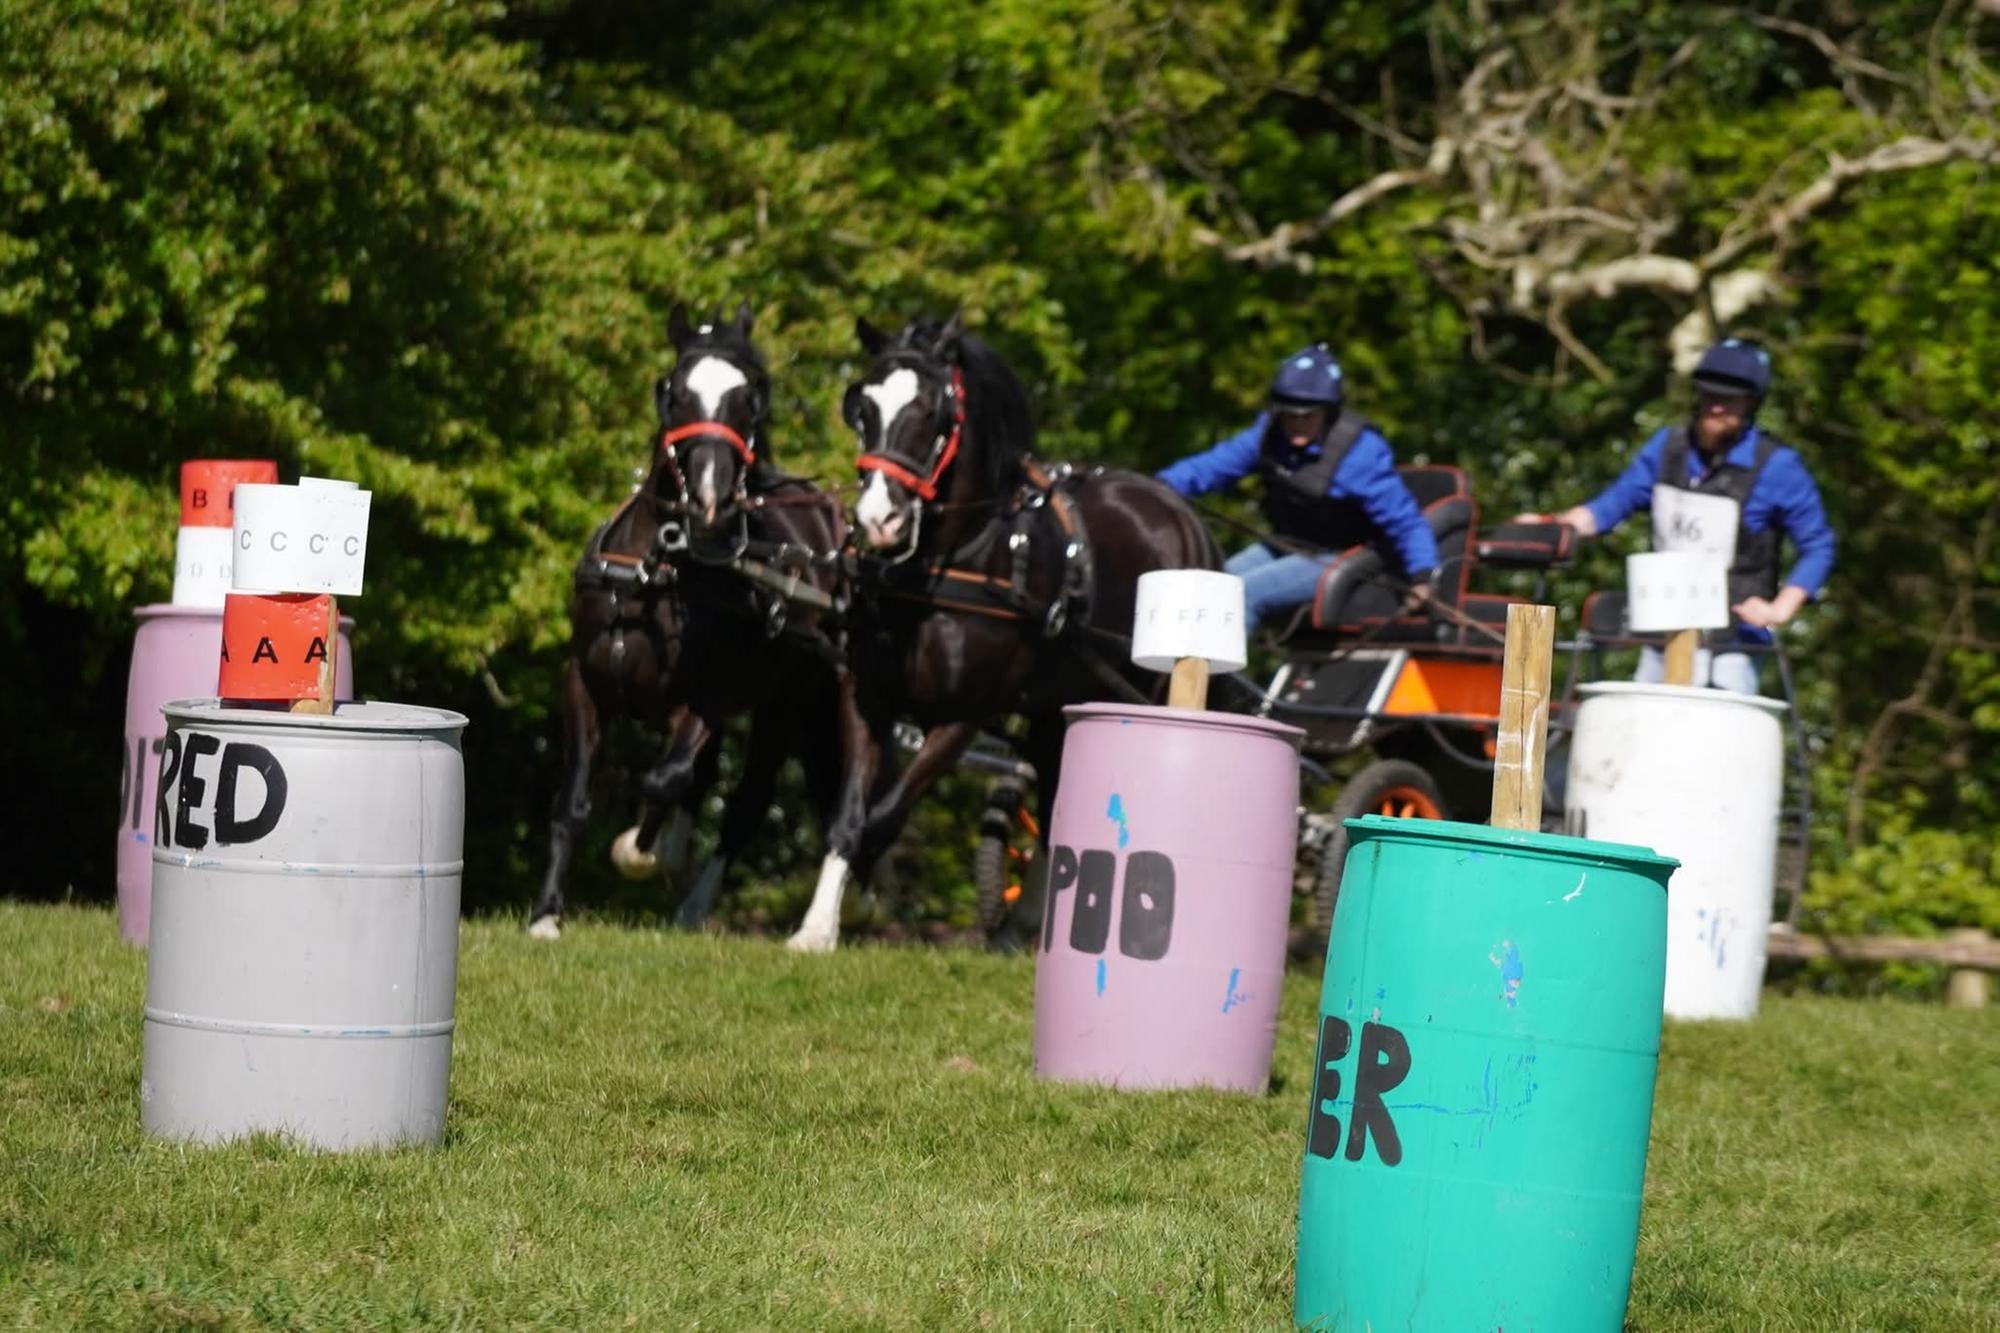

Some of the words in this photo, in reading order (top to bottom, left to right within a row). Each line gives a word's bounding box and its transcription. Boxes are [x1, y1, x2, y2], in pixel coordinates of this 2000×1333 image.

[192, 490, 208, 509] B
[270, 531, 288, 552] C
[309, 534, 325, 554] C
[344, 536, 359, 556] C
[252, 636, 278, 664] A
[304, 636, 327, 664] A
